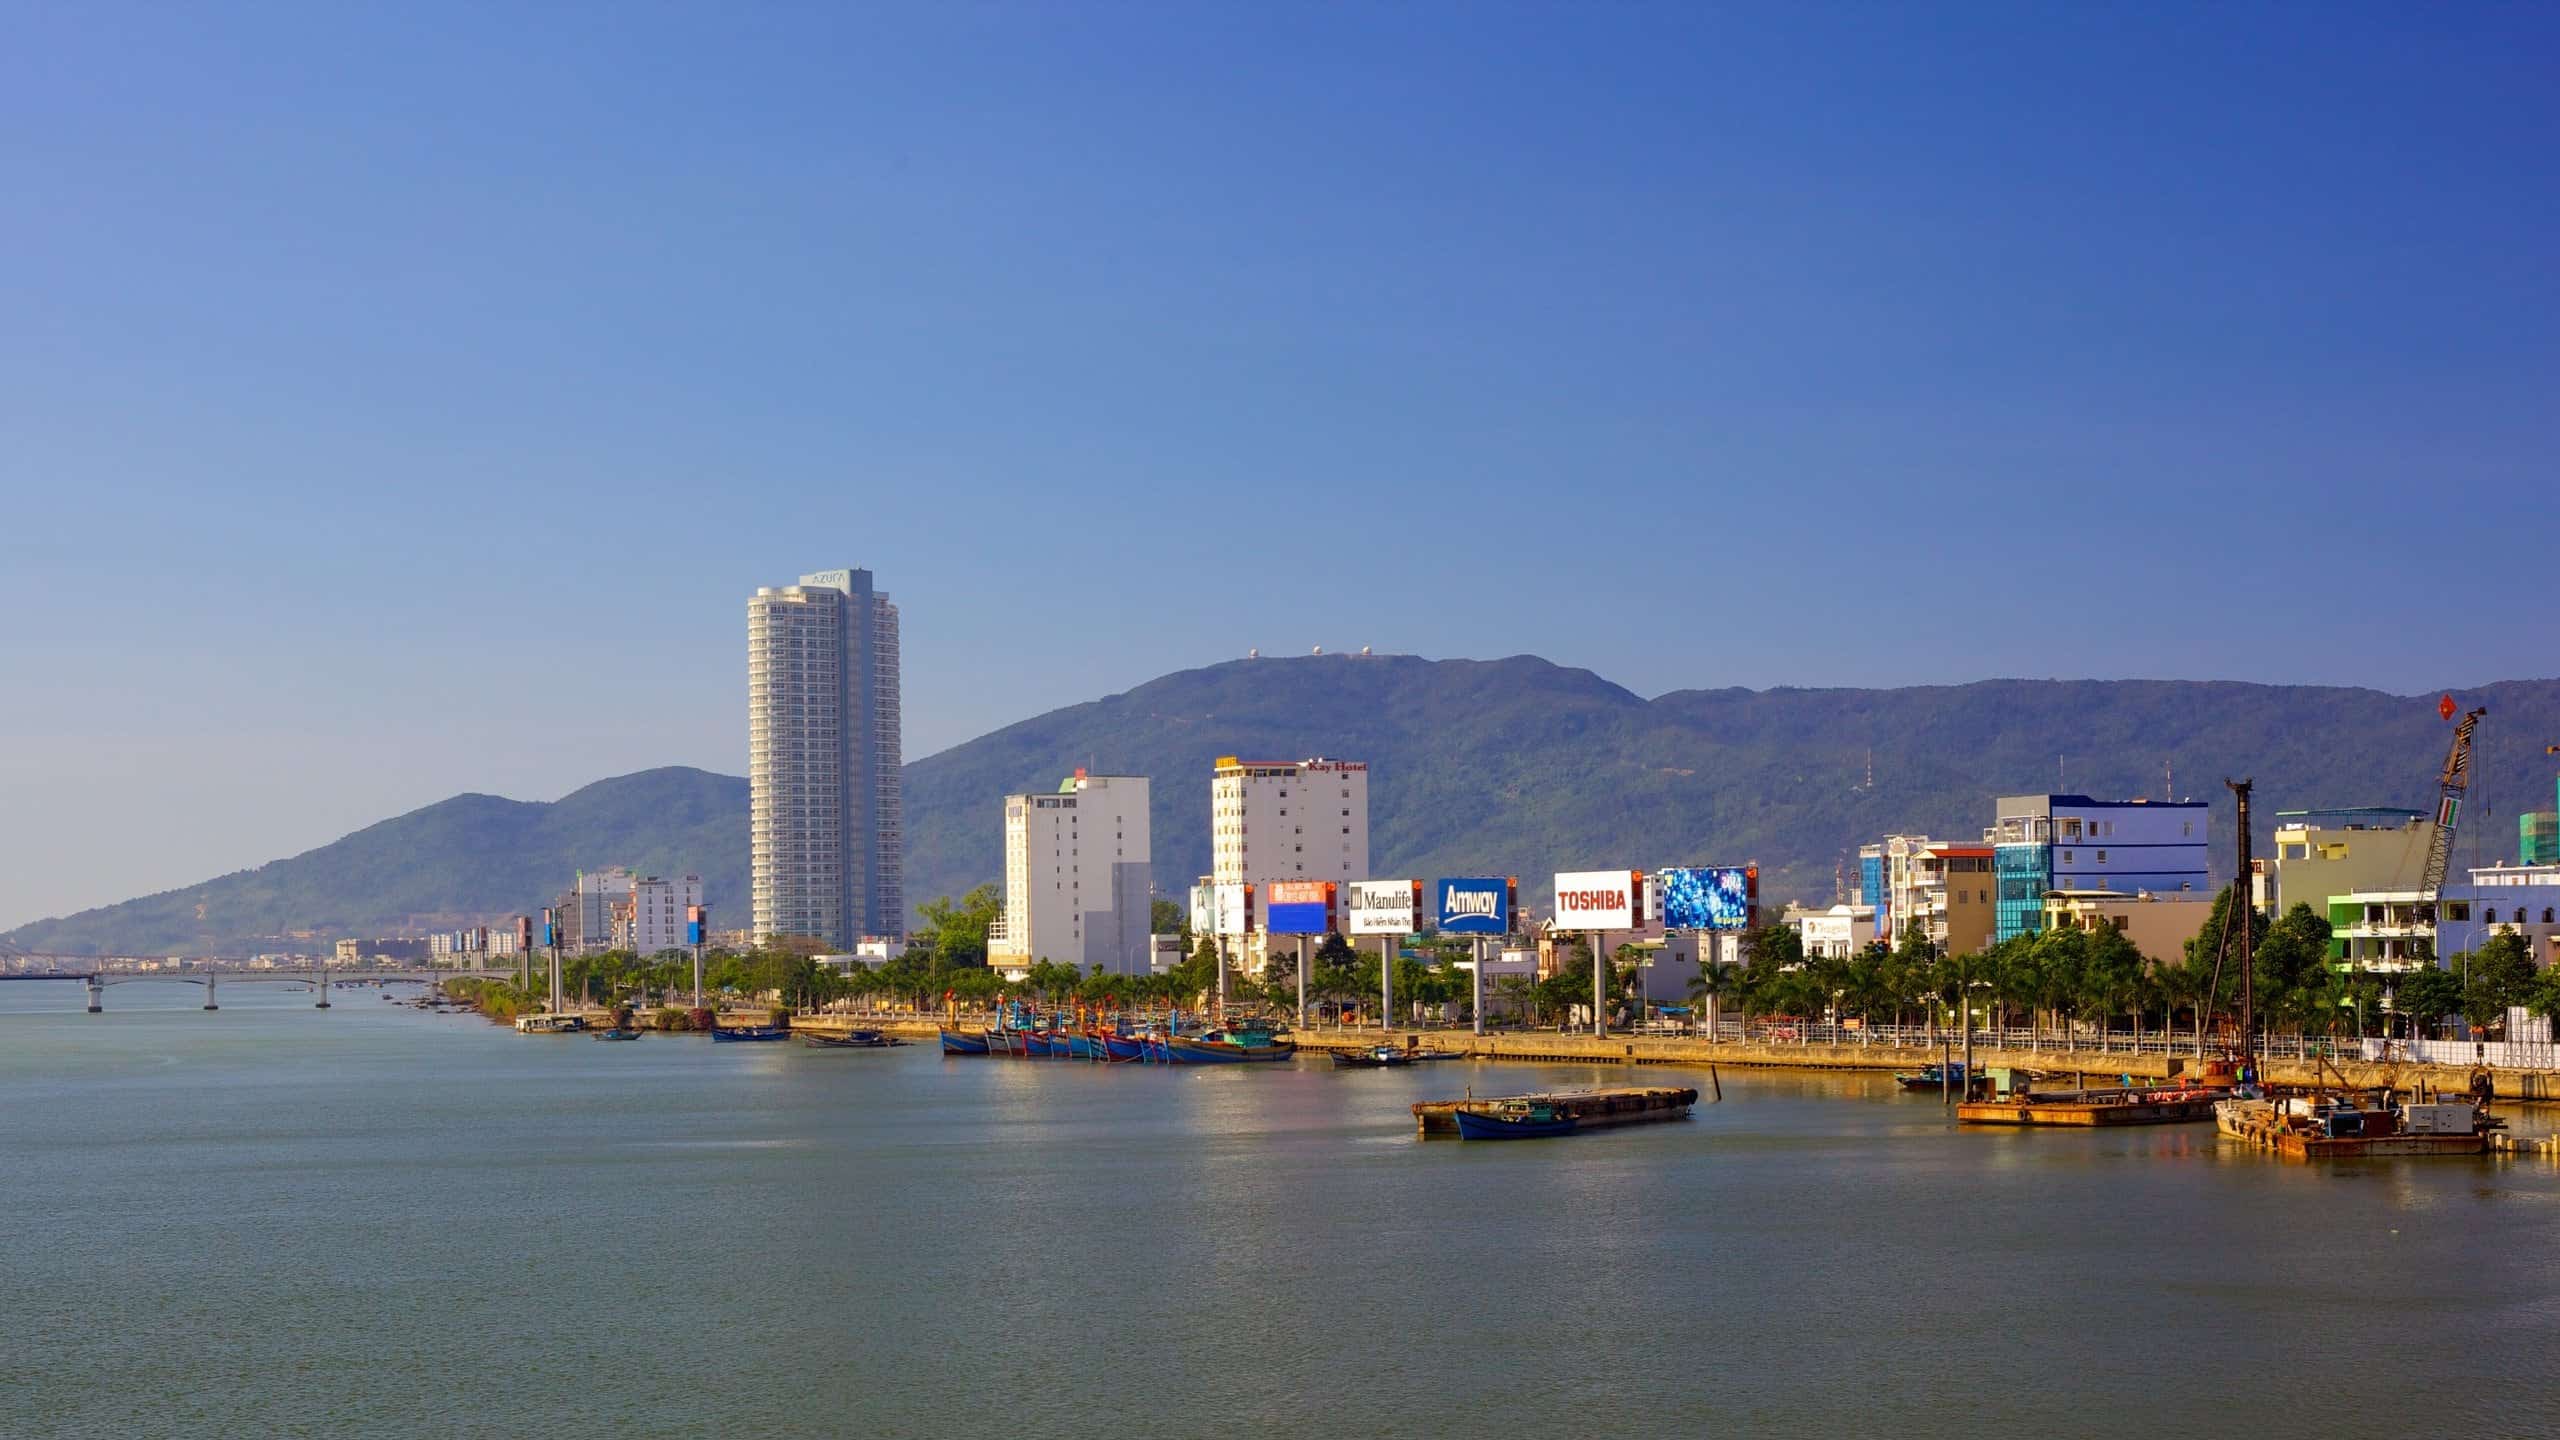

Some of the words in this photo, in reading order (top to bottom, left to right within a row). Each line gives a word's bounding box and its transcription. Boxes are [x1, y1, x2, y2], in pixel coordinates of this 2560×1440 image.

[1308, 761, 1330, 774] Kay
[1335, 761, 1367, 771] Hotel
[1364, 890, 1411, 910] Manulife
[1445, 885, 1498, 918] Amway
[1558, 890, 1626, 911] TOSHIBA
